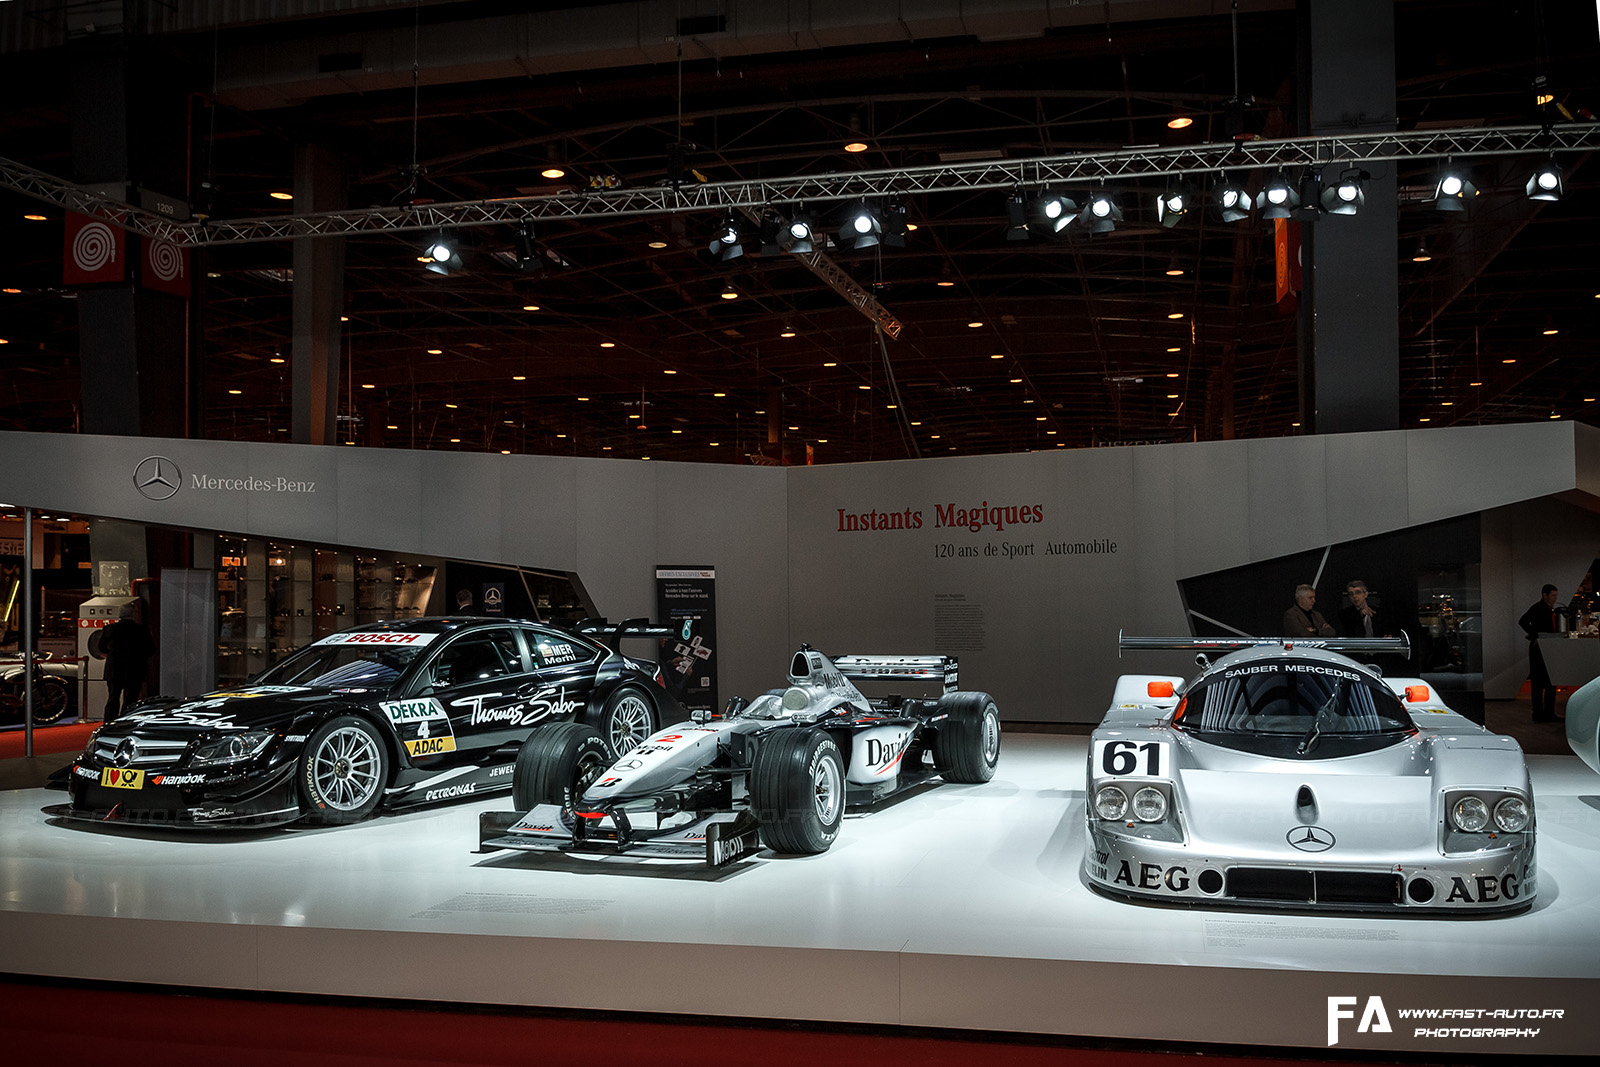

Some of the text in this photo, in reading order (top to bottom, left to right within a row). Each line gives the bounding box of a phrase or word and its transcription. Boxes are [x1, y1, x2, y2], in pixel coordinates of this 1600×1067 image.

[156, 203, 174, 215] 1209
[191, 474, 316, 494] Mercedes-Benz
[837, 501, 1044, 533] Instants Magiques
[934, 538, 1118, 560] 120 ans de Sport Automobile
[345, 634, 420, 643] BOSCH
[551, 644, 573, 656] MER
[544, 654, 576, 665] Merhi
[1225, 665, 1361, 682] SAUBER MERCEDES
[389, 702, 438, 720] DEKRA
[450, 686, 584, 726] Thomas Sabo
[417, 720, 430, 739] 4
[655, 734, 683, 743] 2
[413, 738, 444, 756] ADAC
[1103, 741, 1160, 776] 61
[425, 783, 477, 801] PETRONAS
[713, 836, 744, 866] Mobil
[1114, 859, 1190, 892] AEG
[1445, 873, 1520, 903] AEG
